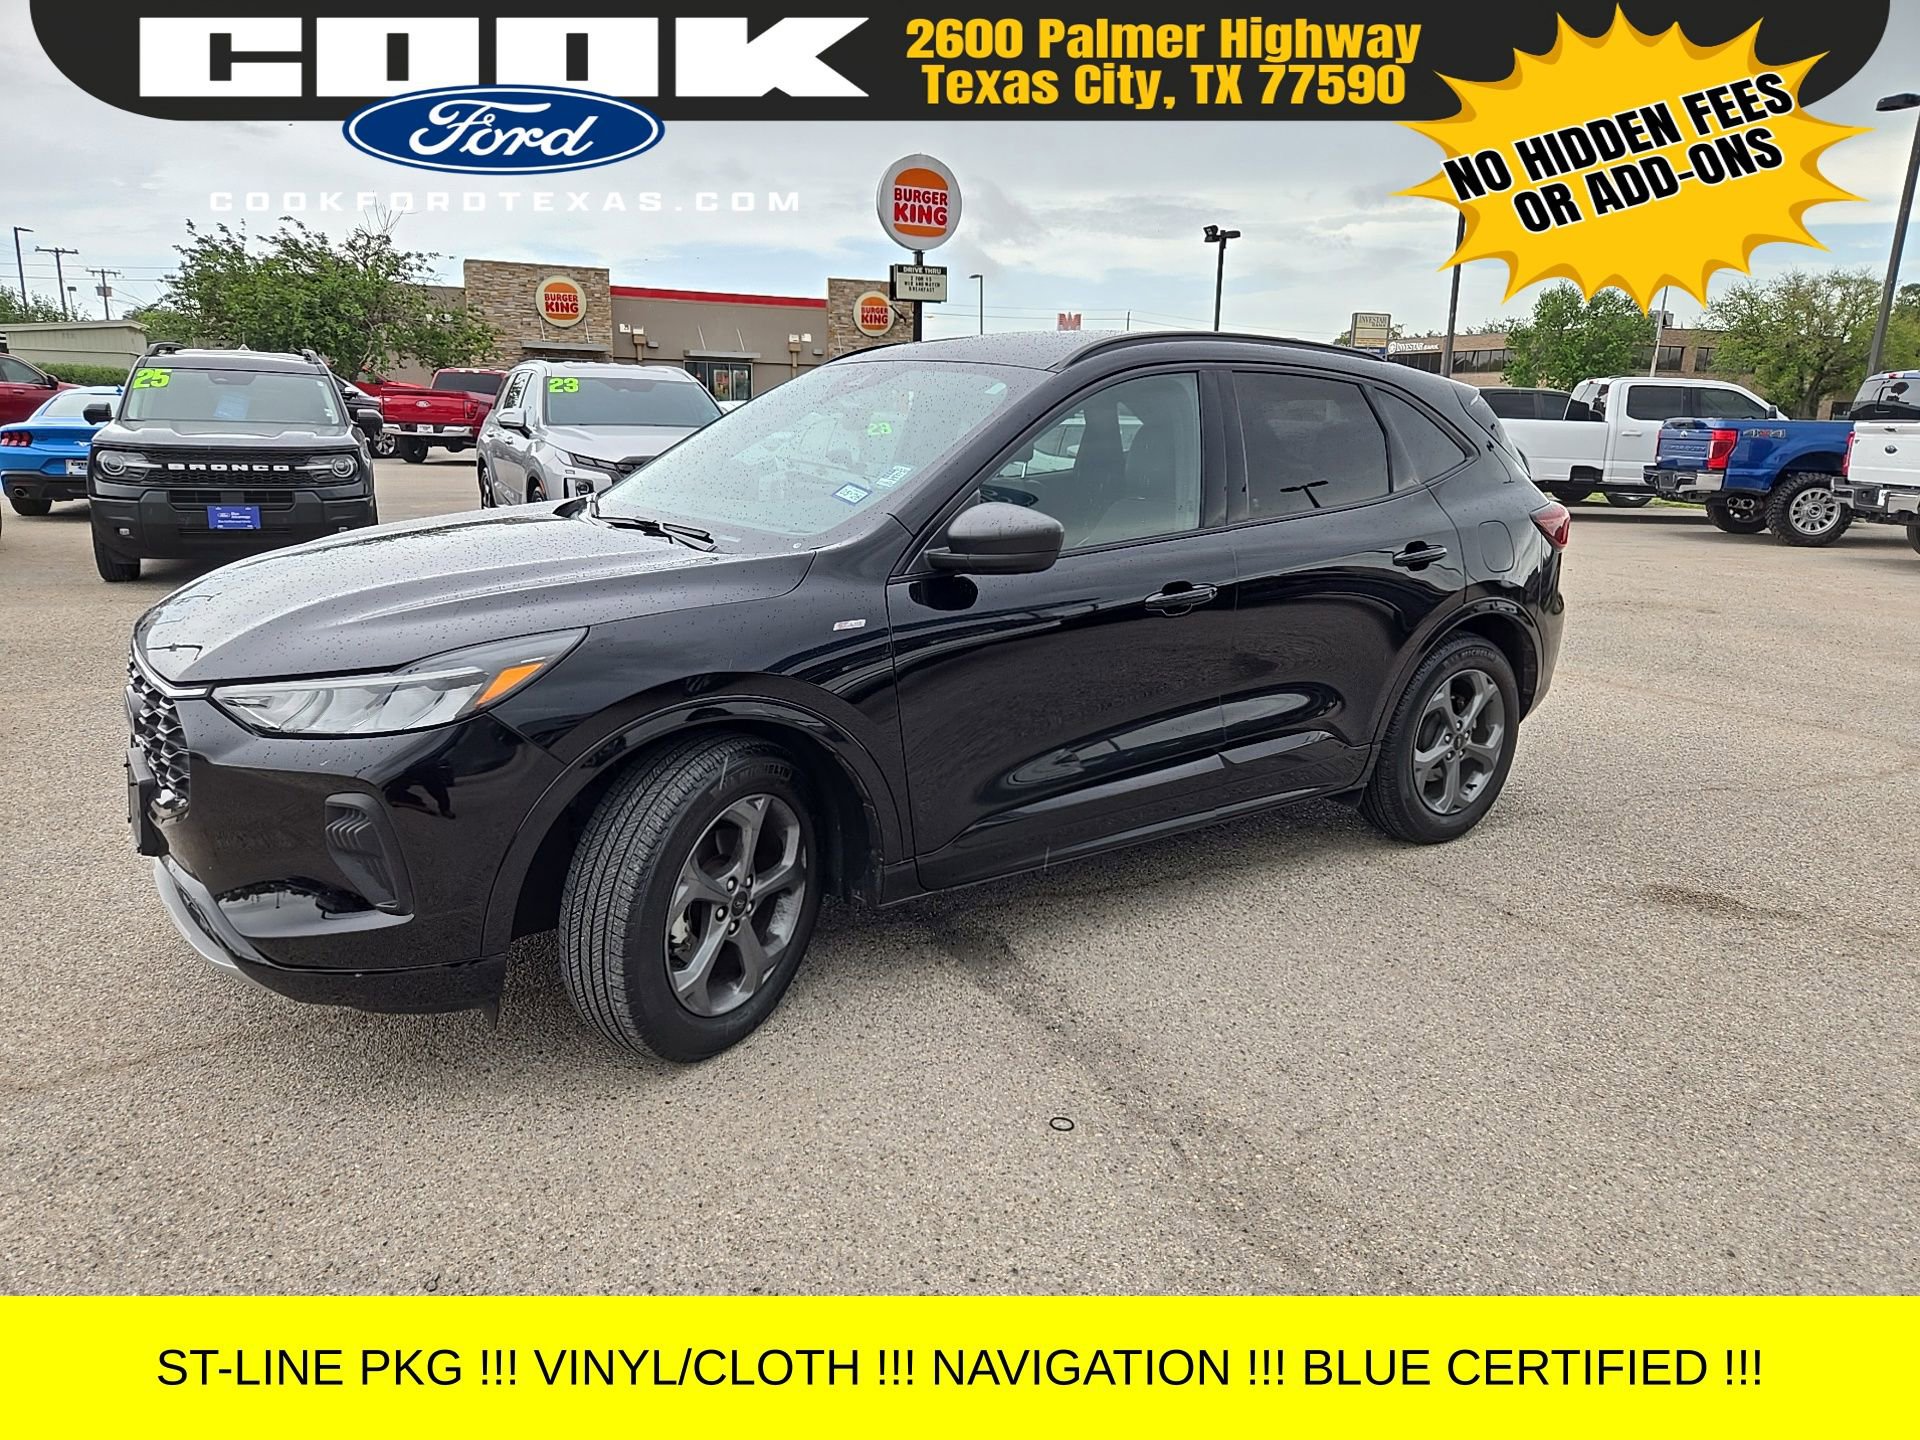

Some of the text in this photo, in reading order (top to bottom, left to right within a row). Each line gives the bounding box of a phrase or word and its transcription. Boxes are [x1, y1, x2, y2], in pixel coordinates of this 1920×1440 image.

[894, 187, 948, 206] BURGER
[894, 202, 948, 226] KING
[544, 293, 579, 303] BURGER
[544, 302, 579, 314] KING
[860, 306, 889, 315] BURGER
[861, 314, 888, 325] KING
[1396, 342, 1424, 352] INVESTAR
[133, 369, 173, 389] 25
[549, 377, 580, 393] 23
[167, 463, 290, 472] BRONCO
